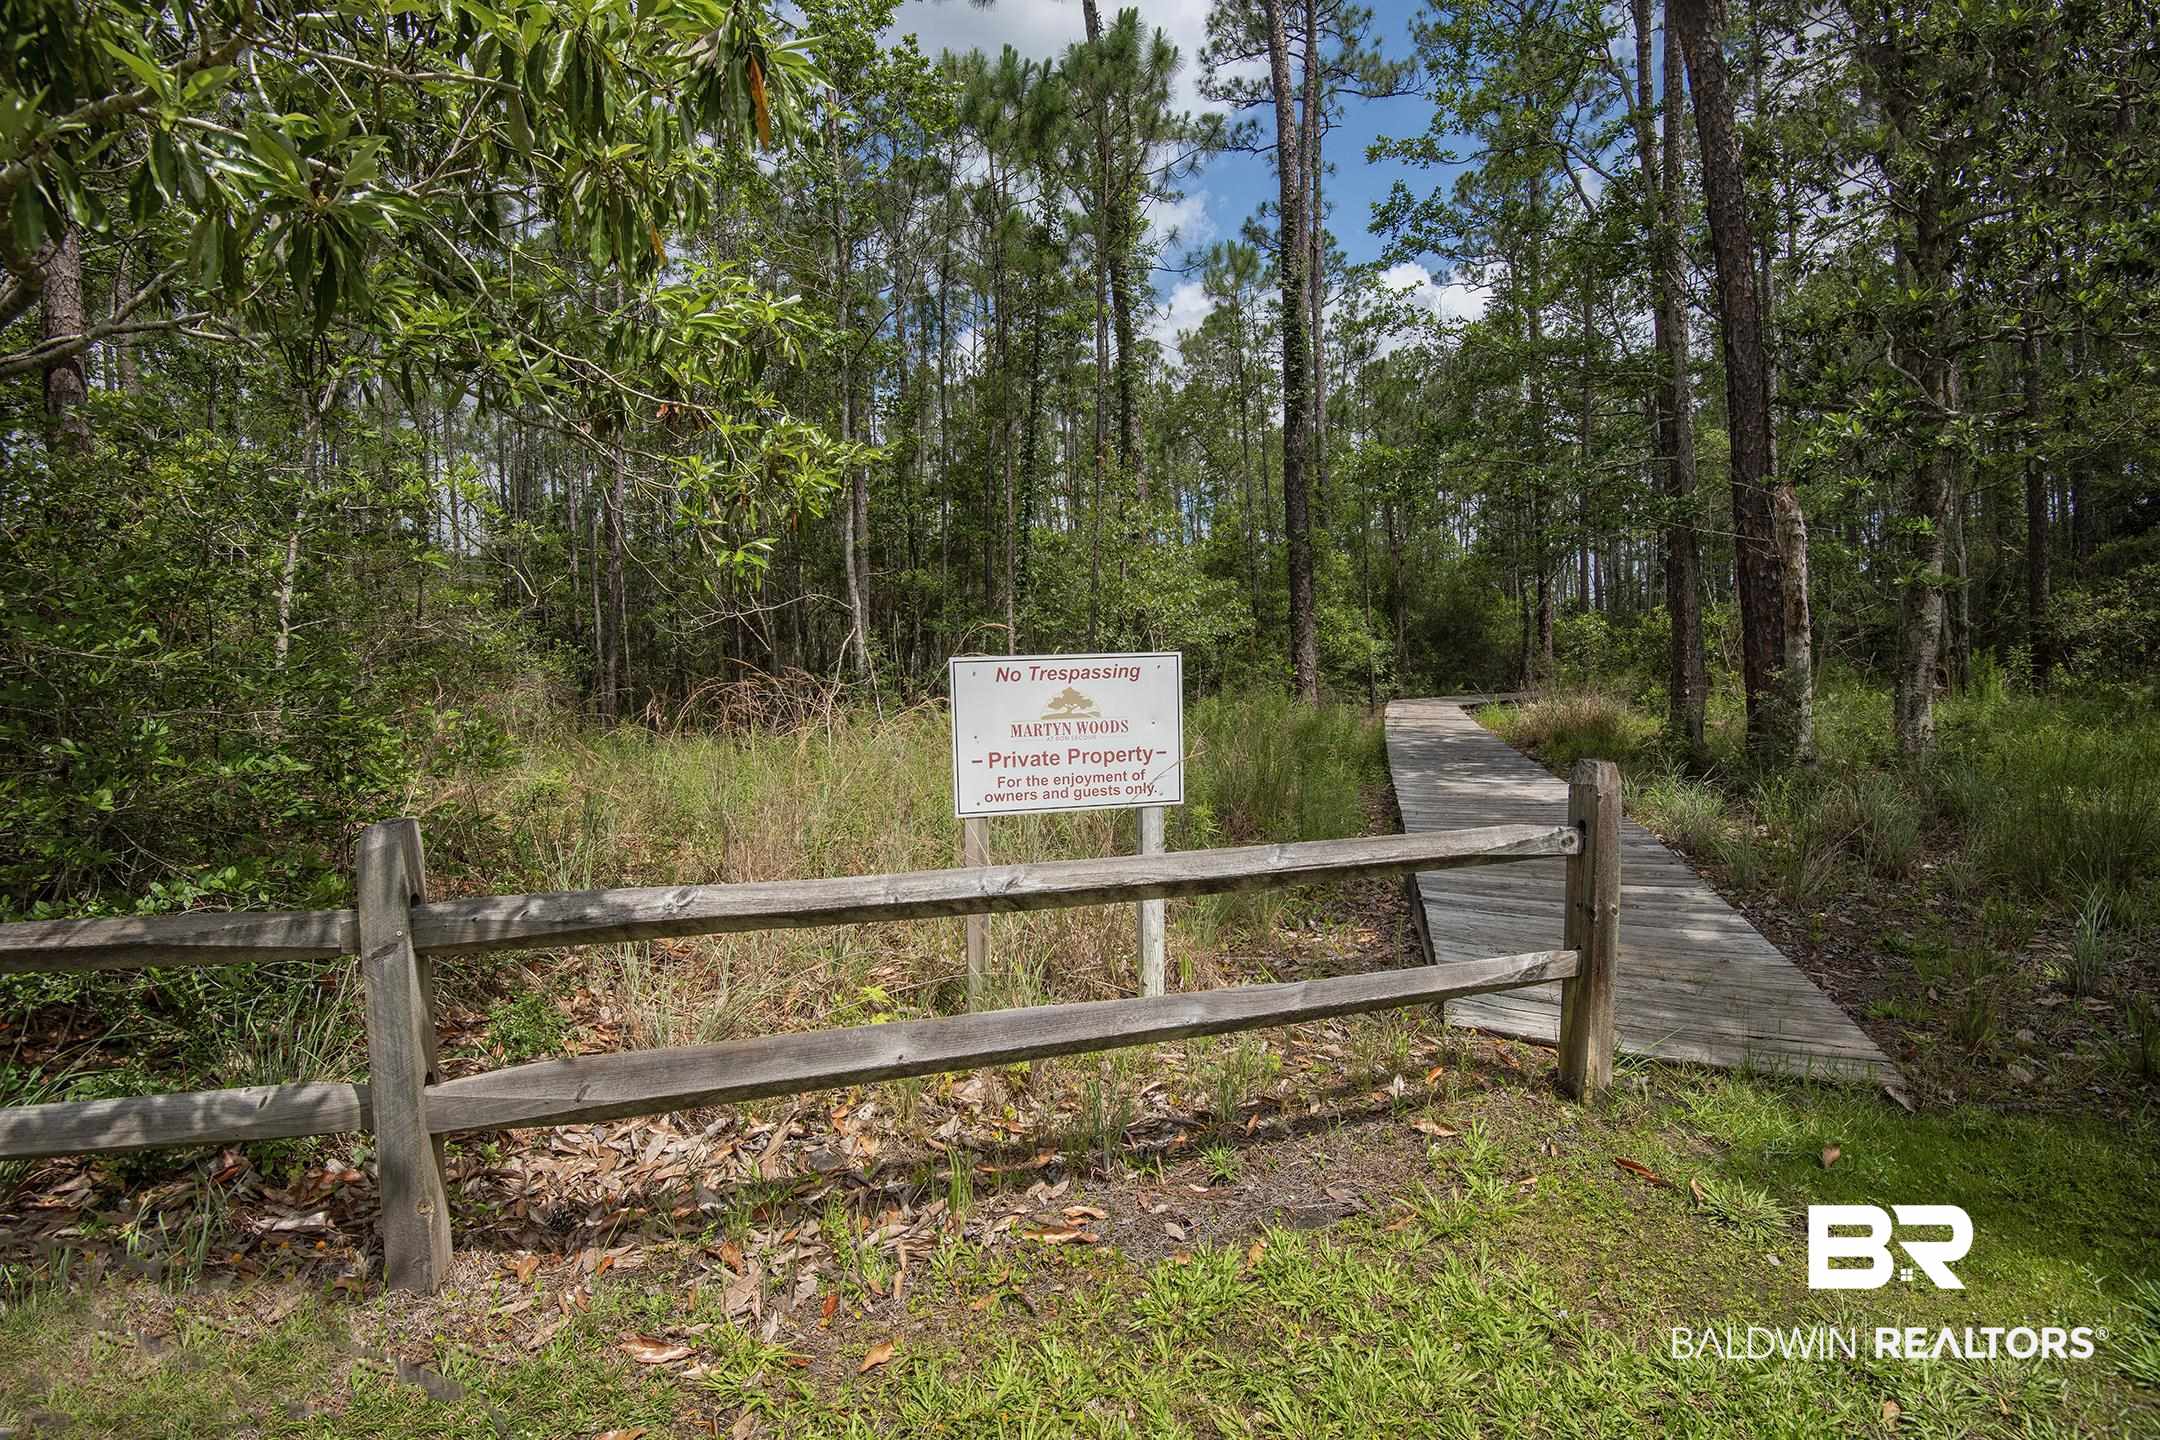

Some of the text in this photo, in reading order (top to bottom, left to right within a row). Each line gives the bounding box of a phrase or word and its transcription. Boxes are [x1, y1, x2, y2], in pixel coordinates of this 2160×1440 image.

[996, 664, 1141, 683] No Trespassing
[1011, 720, 1129, 738] MARTYN WOODS
[988, 746, 1153, 768] Private Property
[998, 769, 1146, 788] For the enjoyment of
[984, 783, 1157, 803] owners and guests only.
